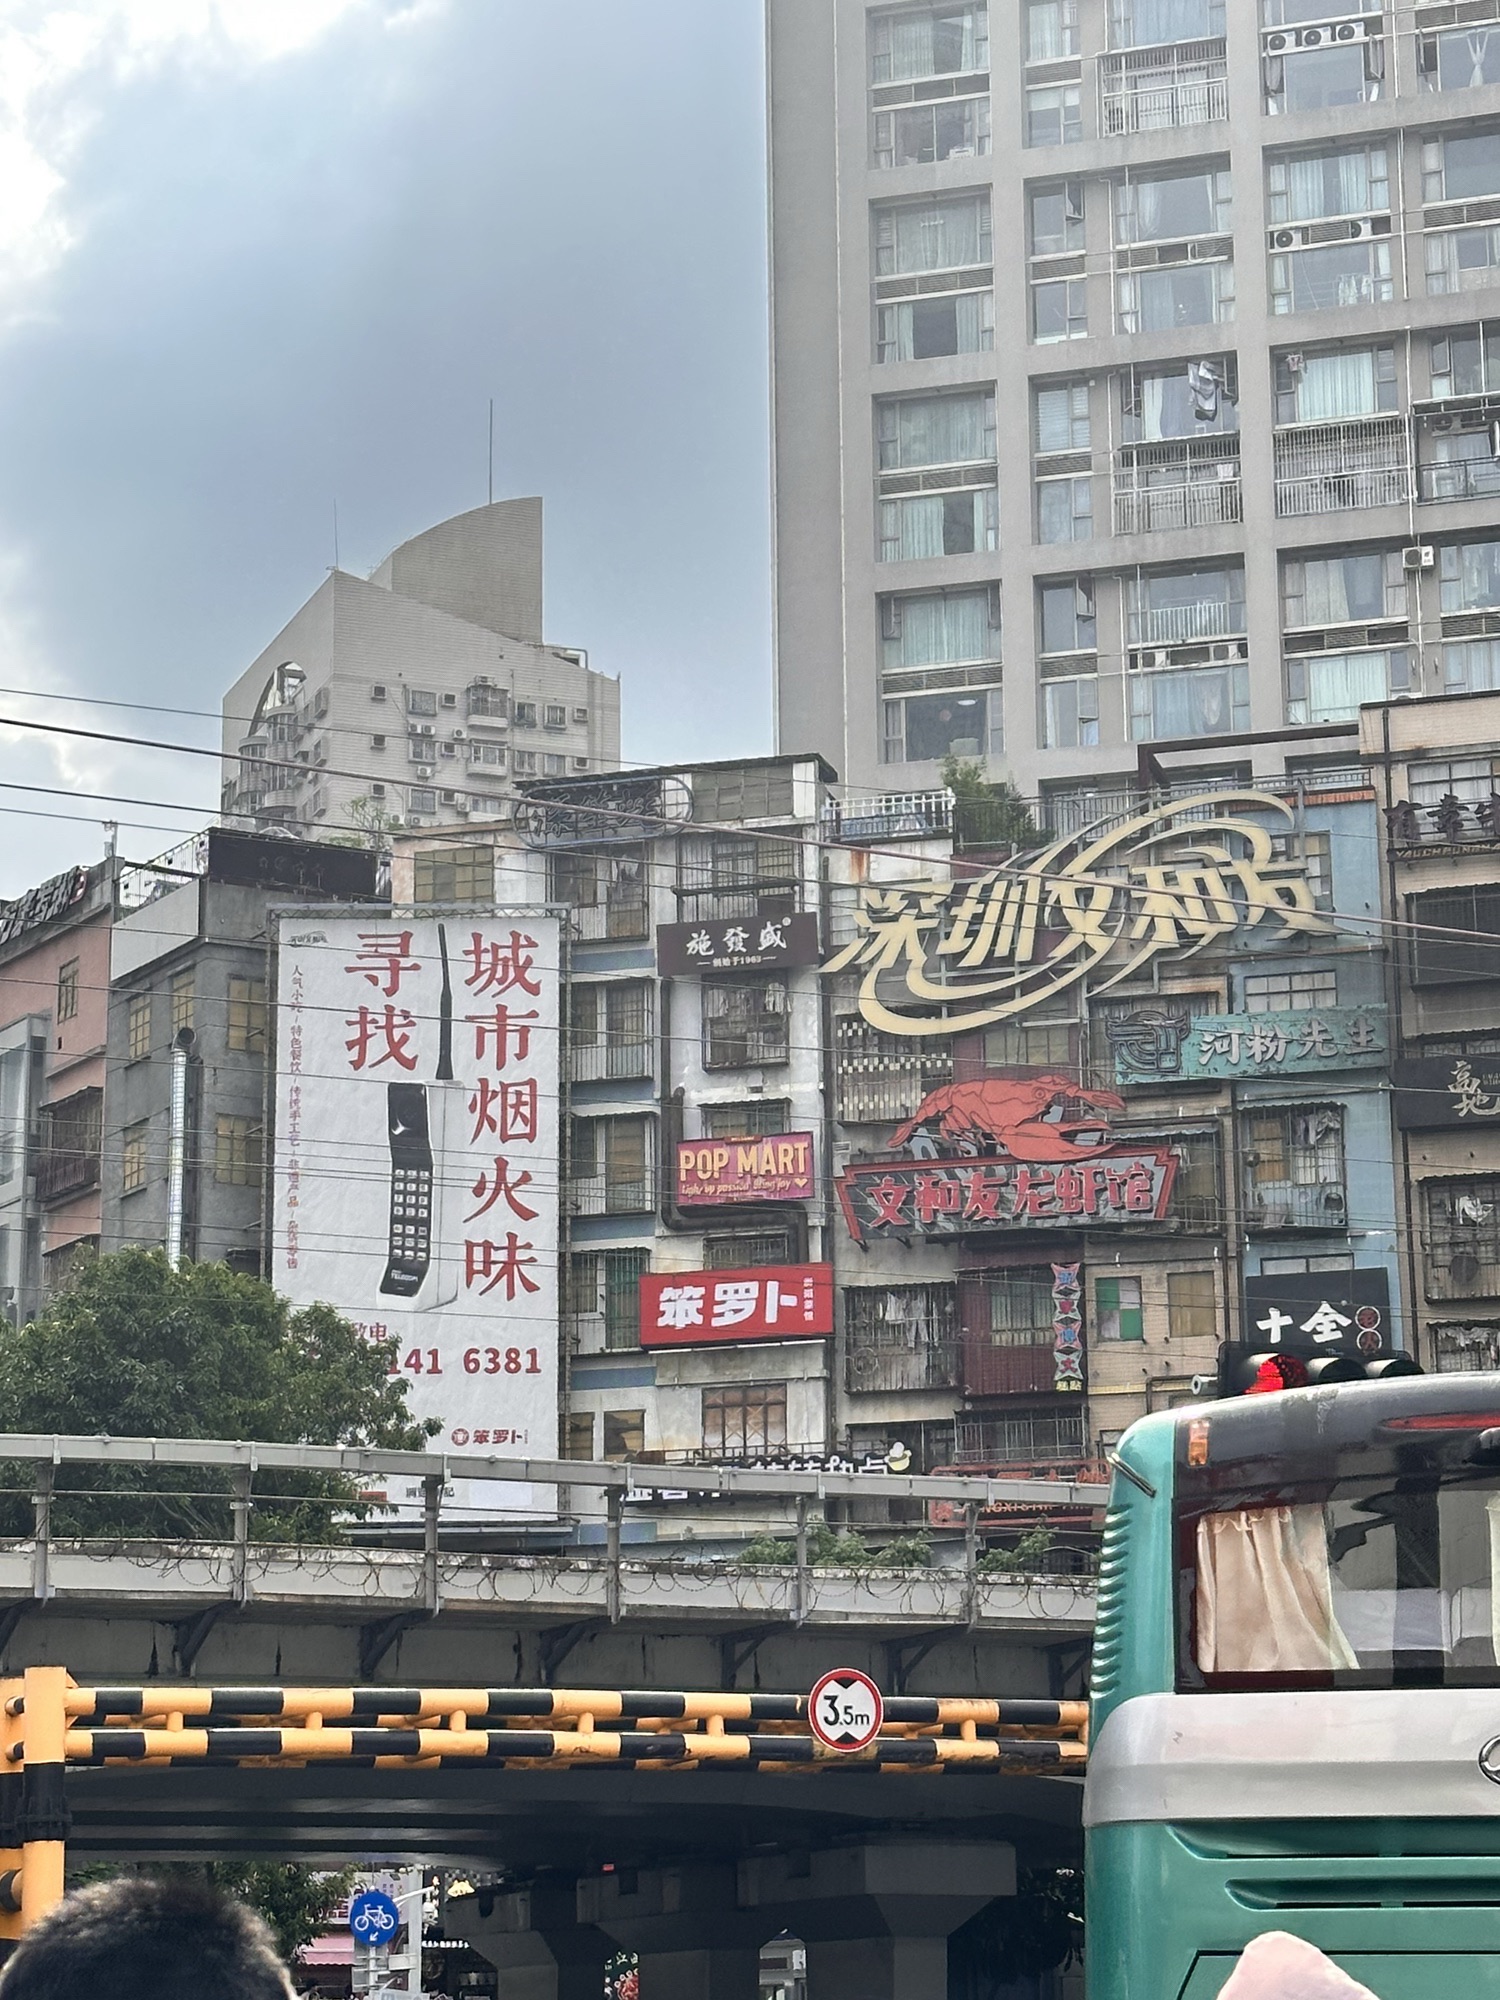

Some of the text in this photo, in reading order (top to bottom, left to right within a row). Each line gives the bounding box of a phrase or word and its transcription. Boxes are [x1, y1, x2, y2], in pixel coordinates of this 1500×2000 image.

[344, 930, 421, 1071] 寻找
[1199, 1017, 1385, 1066] 河粉先生
[463, 930, 543, 1302] 城市烟火味
[680, 1141, 808, 1182] POP MART
[866, 1160, 1152, 1229] 文和友龙虾馆
[656, 1280, 798, 1330] 笨罗卜
[1255, 1301, 1353, 1344] 十全
[463, 1347, 541, 1374] 6381
[823, 1694, 870, 1726] 3.5m
